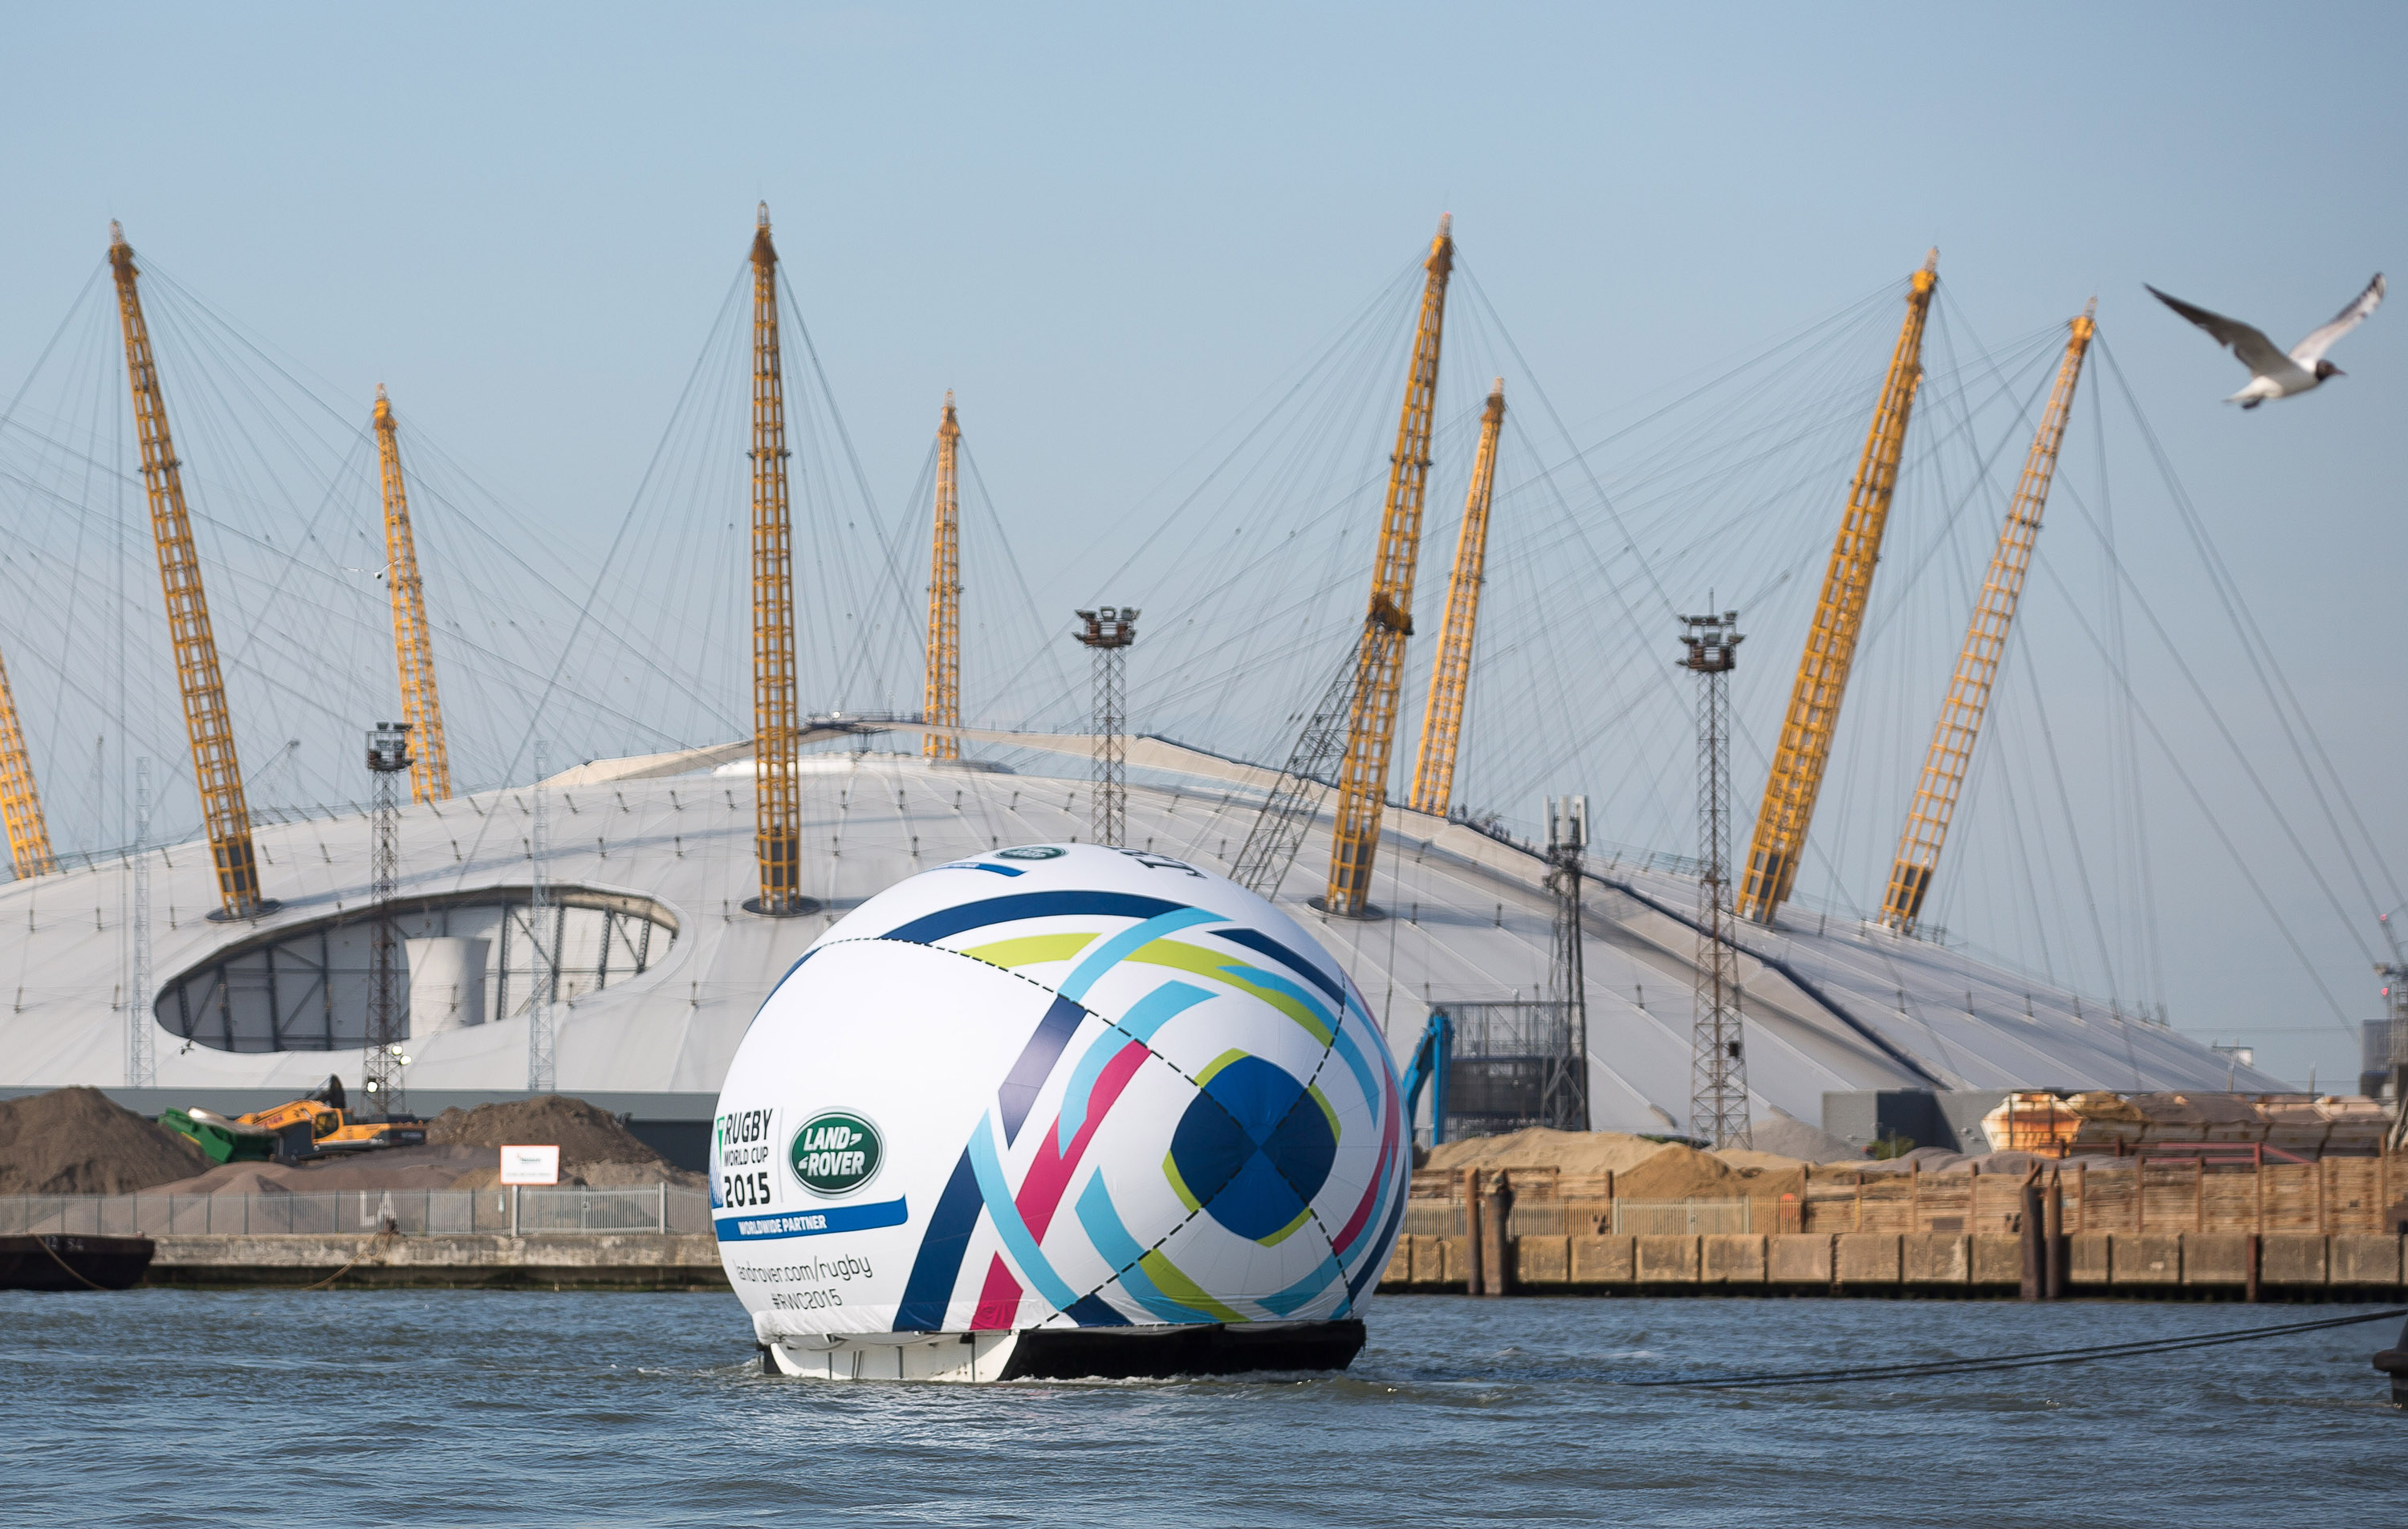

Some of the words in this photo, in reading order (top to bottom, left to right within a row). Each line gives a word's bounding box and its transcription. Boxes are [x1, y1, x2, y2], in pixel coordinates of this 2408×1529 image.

[725, 1108, 773, 1145] RUGBY
[803, 1126, 851, 1151] LAND
[724, 1148, 749, 1166] WORLD
[750, 1146, 769, 1164] CUP
[807, 1150, 865, 1177] ROVER
[724, 1172, 771, 1208] 2015
[738, 1218, 783, 1235] WORLDWIDE
[782, 1214, 828, 1232] PARTNER
[732, 1254, 873, 1283] landrover.com/rugby
[771, 1288, 843, 1310] #RWC2015
